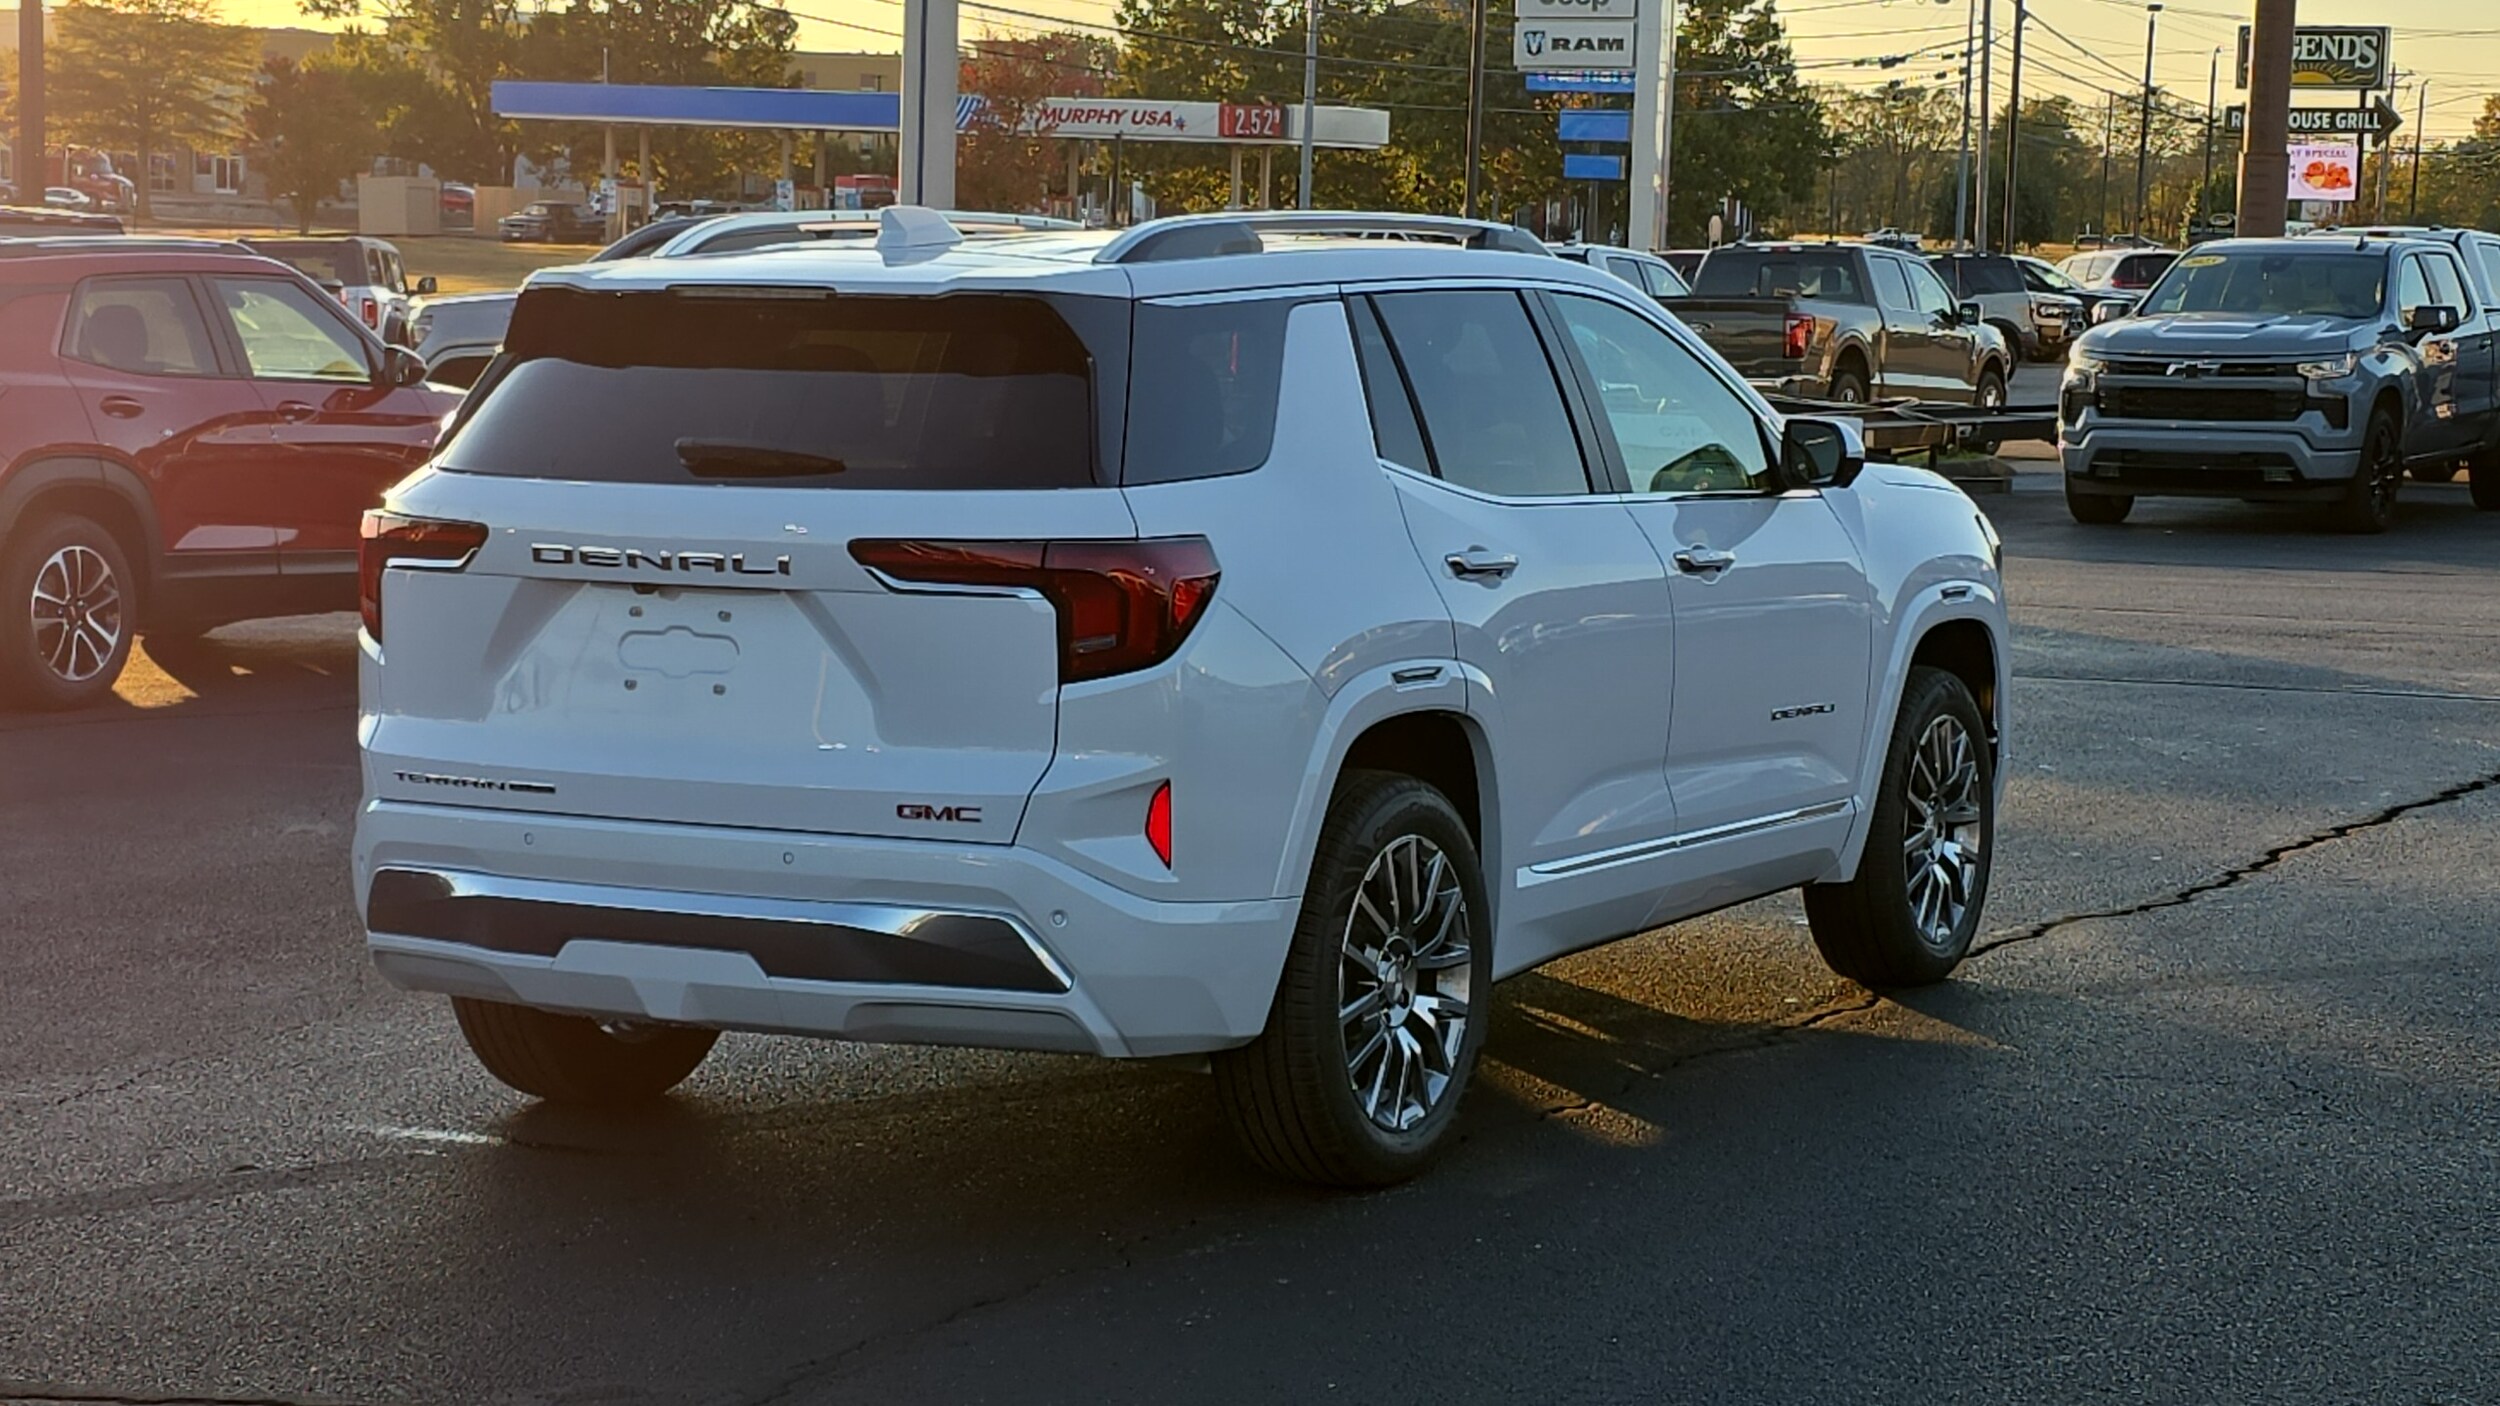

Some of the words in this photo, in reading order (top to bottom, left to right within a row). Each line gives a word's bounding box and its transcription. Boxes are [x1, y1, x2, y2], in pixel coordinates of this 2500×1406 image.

[1551, 38, 1624, 51] RAM
[1041, 107, 1128, 125] MURPHY
[1131, 109, 1172, 127] USA
[2335, 112, 2381, 129] GRILL
[531, 542, 791, 575] DENALI
[1771, 703, 1835, 721] DENALI
[393, 769, 506, 791] TERRAIN
[896, 803, 982, 822] GMC
